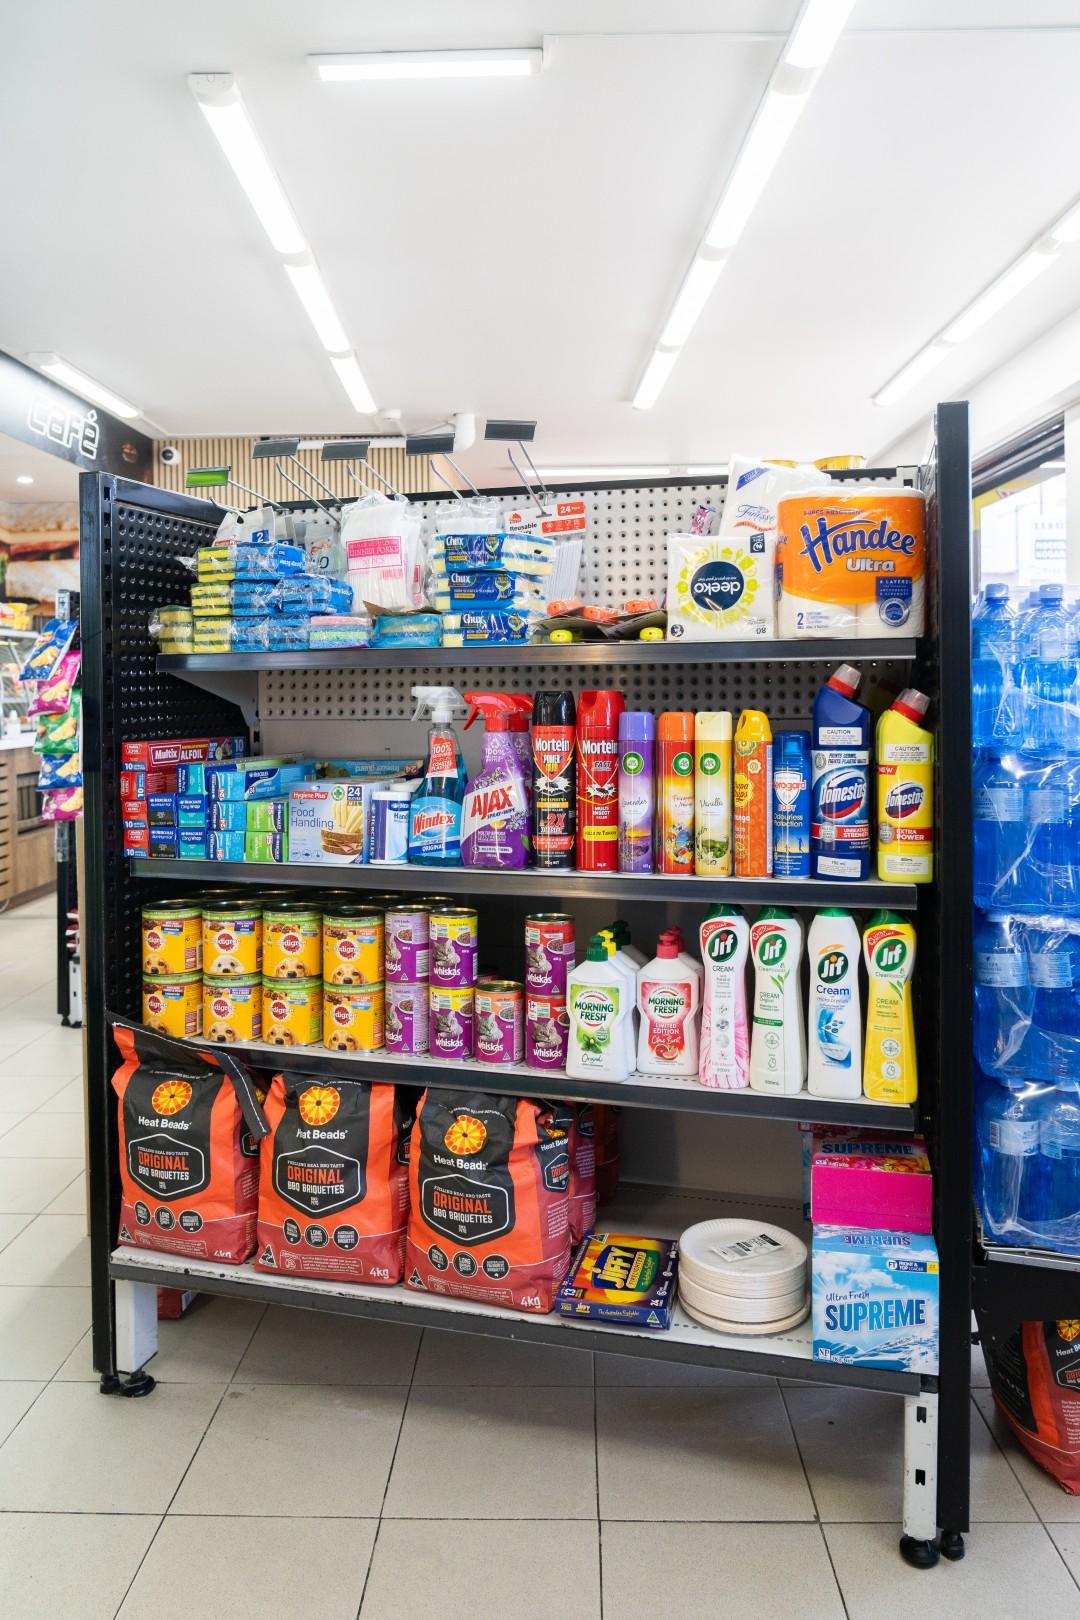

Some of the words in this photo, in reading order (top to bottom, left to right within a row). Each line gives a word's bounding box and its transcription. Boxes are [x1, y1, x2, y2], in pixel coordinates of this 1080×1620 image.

[560, 506, 571, 514] 24
[509, 522, 538, 532] Reusable
[256, 532, 264, 543] 2
[446, 535, 464, 547] Chux
[800, 516, 917, 572] Handee
[846, 557, 896, 572] Ultra
[450, 572, 471, 584] Chux
[694, 581, 742, 596] deeko
[797, 612, 804, 626] 2
[756, 627, 767, 635] 80
[234, 739, 244, 753] 10
[433, 743, 452, 754] 100%
[535, 737, 570, 752] Mortein
[582, 739, 618, 755] Mortein
[154, 748, 178, 760] Multix
[181, 749, 203, 760] ALFOIL
[125, 762, 133, 770] 10
[773, 780, 807, 791] erogard
[137, 787, 145, 798] 10
[293, 791, 314, 800] Hygiene
[347, 787, 361, 797] 24
[819, 778, 867, 807] Domestos
[885, 789, 924, 807] Domestos
[470, 785, 513, 820] AJAX
[291, 806, 315, 818] Food
[124, 820, 133, 828] 10
[291, 818, 334, 831] Handling
[413, 812, 456, 838] Windex
[126, 848, 135, 856] 10
[422, 844, 445, 852] ORIGINAL
[711, 932, 735, 957] Jif
[762, 938, 784, 961] Jif
[879, 943, 903, 967] Jif
[712, 965, 734, 973] CREAM
[820, 954, 846, 979] Jif
[759, 991, 780, 999] CREAM
[816, 984, 850, 996] Cream
[528, 1000, 536, 1009] 1+
[574, 1000, 614, 1013] MORNING
[648, 996, 685, 1005] MORNING
[875, 997, 899, 1005] CREAM
[653, 1005, 679, 1015] FRESH
[580, 1012, 607, 1021] FRESH
[653, 1027, 680, 1035] EDITION
[138, 1115, 159, 1128] Heat
[161, 1118, 190, 1131] Beads
[313, 1129, 347, 1140] Beads
[541, 1141, 556, 1152] Heat
[821, 1142, 913, 1155] SUPREME
[138, 1150, 190, 1171] ORIGINAL
[433, 1154, 455, 1167] Heat
[138, 1165, 150, 1177] BBQ
[150, 1168, 190, 1181] BRIQUETTES
[287, 1165, 344, 1185] ORIGINAL
[287, 1180, 300, 1193] BBQ
[302, 1183, 345, 1195] BRIQUETTES
[433, 1190, 492, 1214] ORIGINAL
[433, 1207, 447, 1219] BBQ
[448, 1210, 493, 1224] BRIQUETTES
[843, 1235, 911, 1246] SUPREME
[369, 1267, 390, 1280] 4kg
[595, 1246, 636, 1289] JIFFY
[563, 1288, 576, 1297] 13
[825, 1291, 848, 1301] Ultra
[848, 1290, 870, 1300] Fresh
[520, 1295, 541, 1309] 4kg
[825, 1298, 926, 1333] SUPREME
[819, 1348, 830, 1357] NP
[1055, 1347, 1075, 1357] Heat
